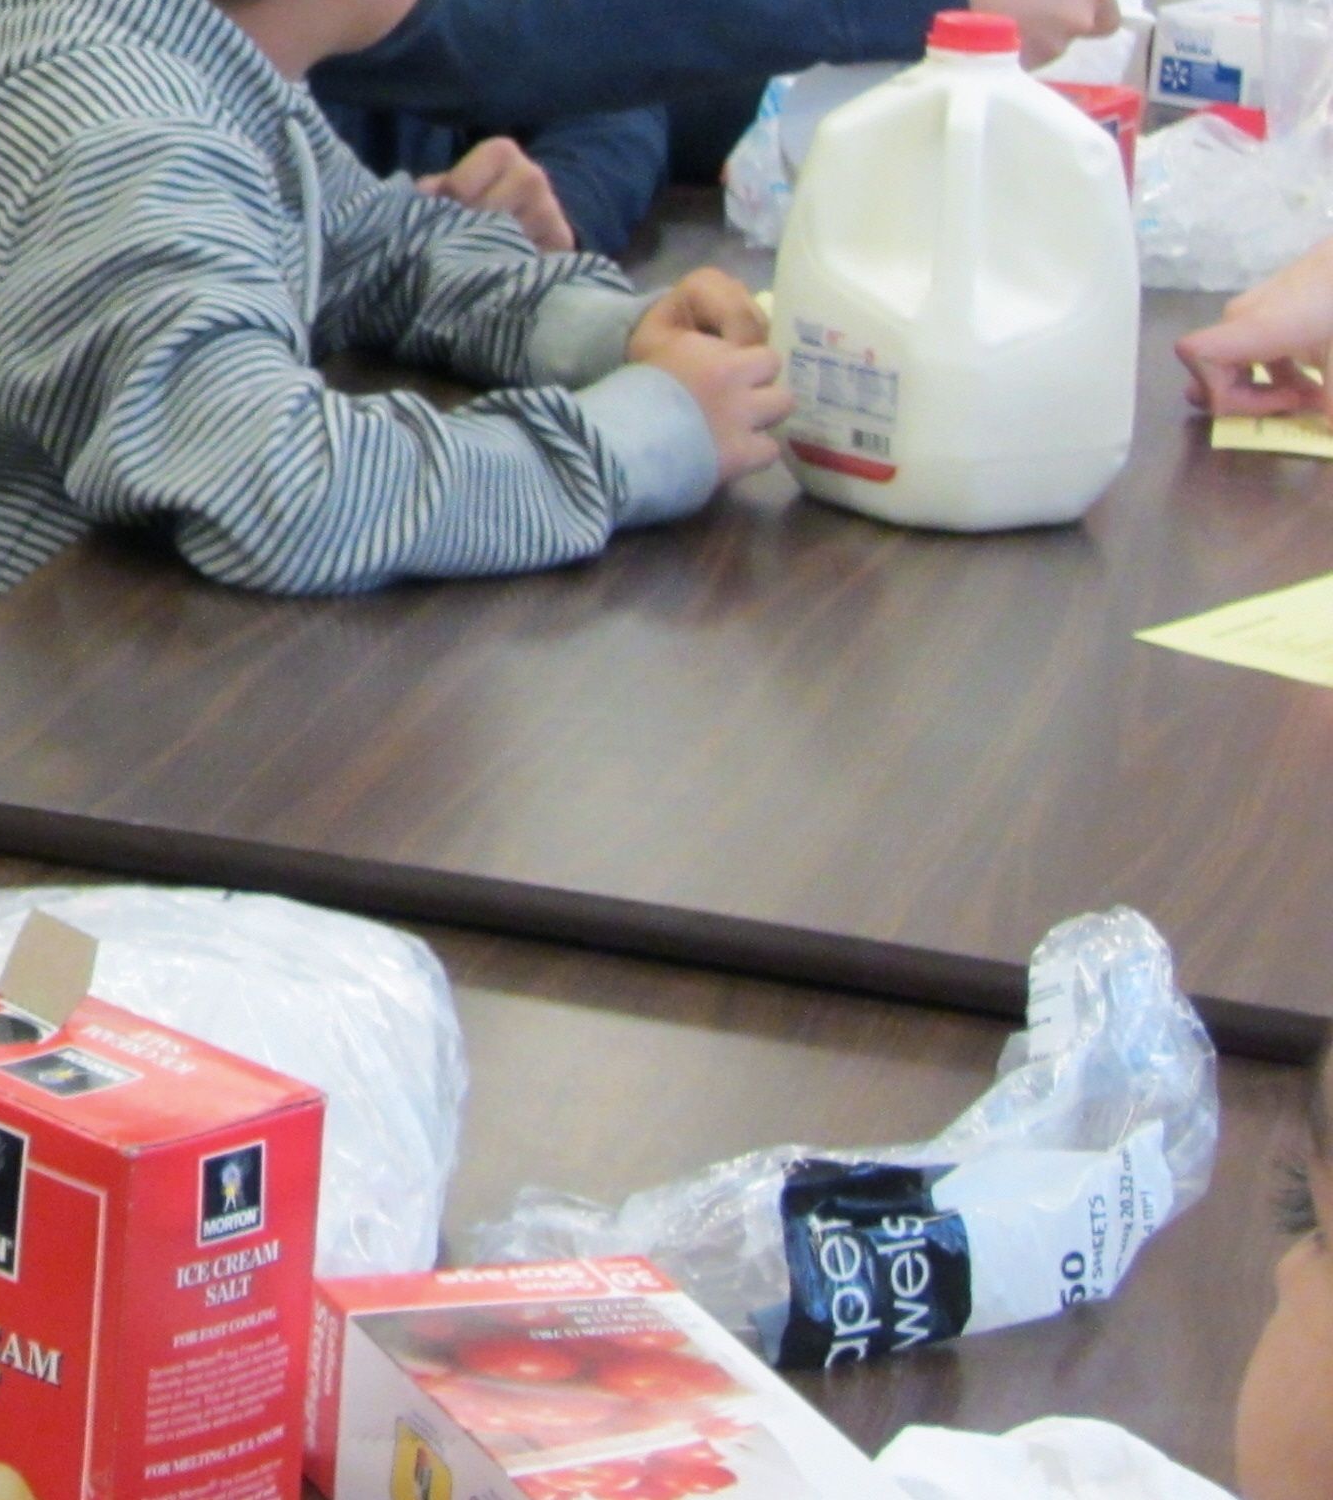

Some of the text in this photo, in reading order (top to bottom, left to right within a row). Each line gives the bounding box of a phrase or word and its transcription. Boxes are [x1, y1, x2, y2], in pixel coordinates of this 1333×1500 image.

[1119, 1174, 1134, 1219] 20.32
[202, 1208, 259, 1238] MORTON
[1089, 1193, 1106, 1279] SHEETS
[175, 1239, 281, 1290] ICE CREAM
[435, 1263, 586, 1285] Storage
[878, 1213, 932, 1350] wels
[204, 1276, 253, 1308] SALT
[815, 1214, 882, 1368] aper
